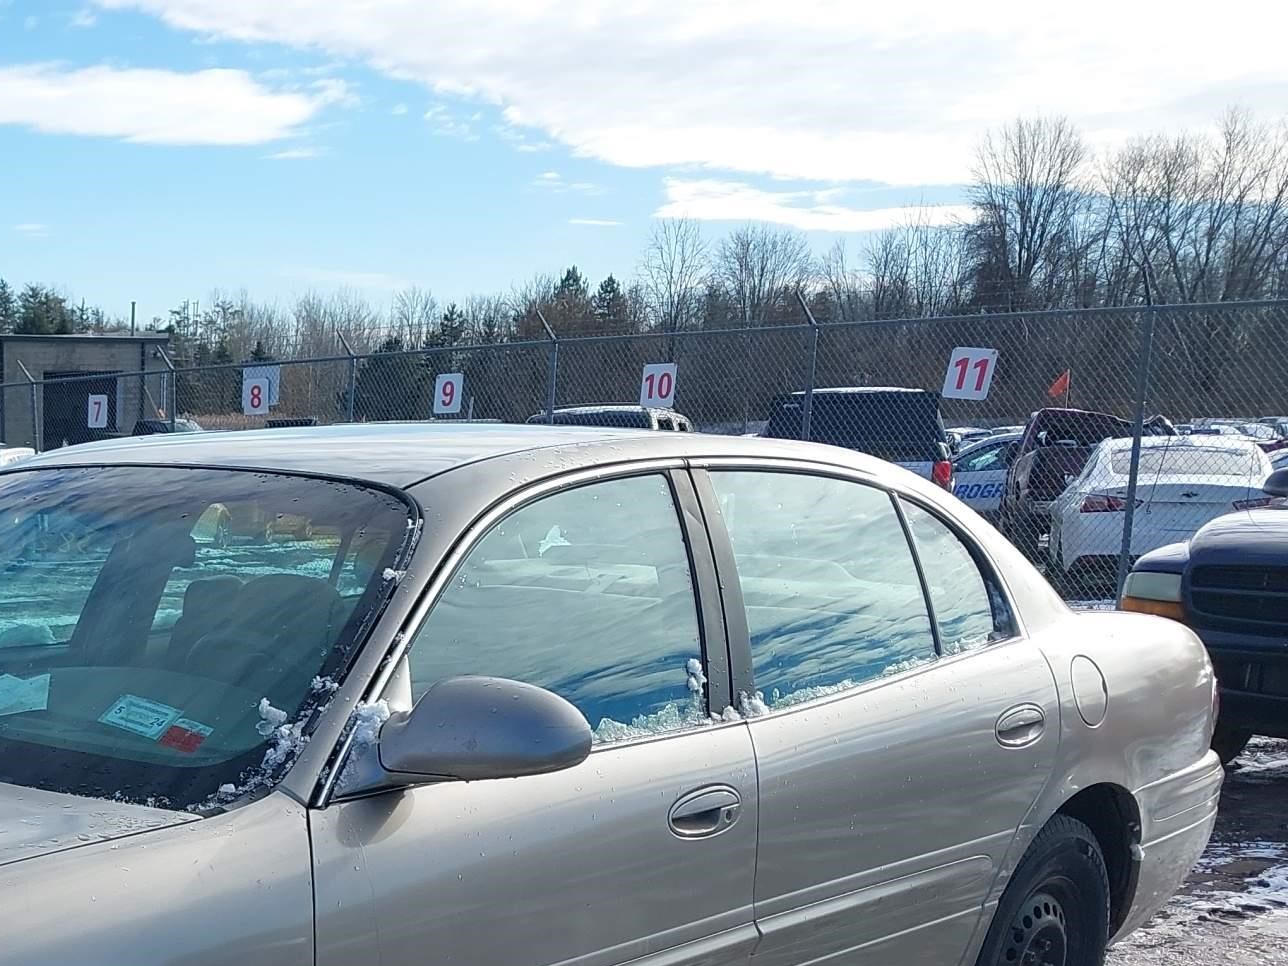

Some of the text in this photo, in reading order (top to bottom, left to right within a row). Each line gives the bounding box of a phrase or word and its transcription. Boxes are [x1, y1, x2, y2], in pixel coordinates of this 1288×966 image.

[645, 372, 673, 400] 10
[955, 357, 989, 391] 11
[250, 385, 262, 409] 8
[441, 380, 455, 407] 9
[93, 401, 102, 422] 7
[954, 483, 1004, 499] ROGR
[114, 705, 126, 715] 5
